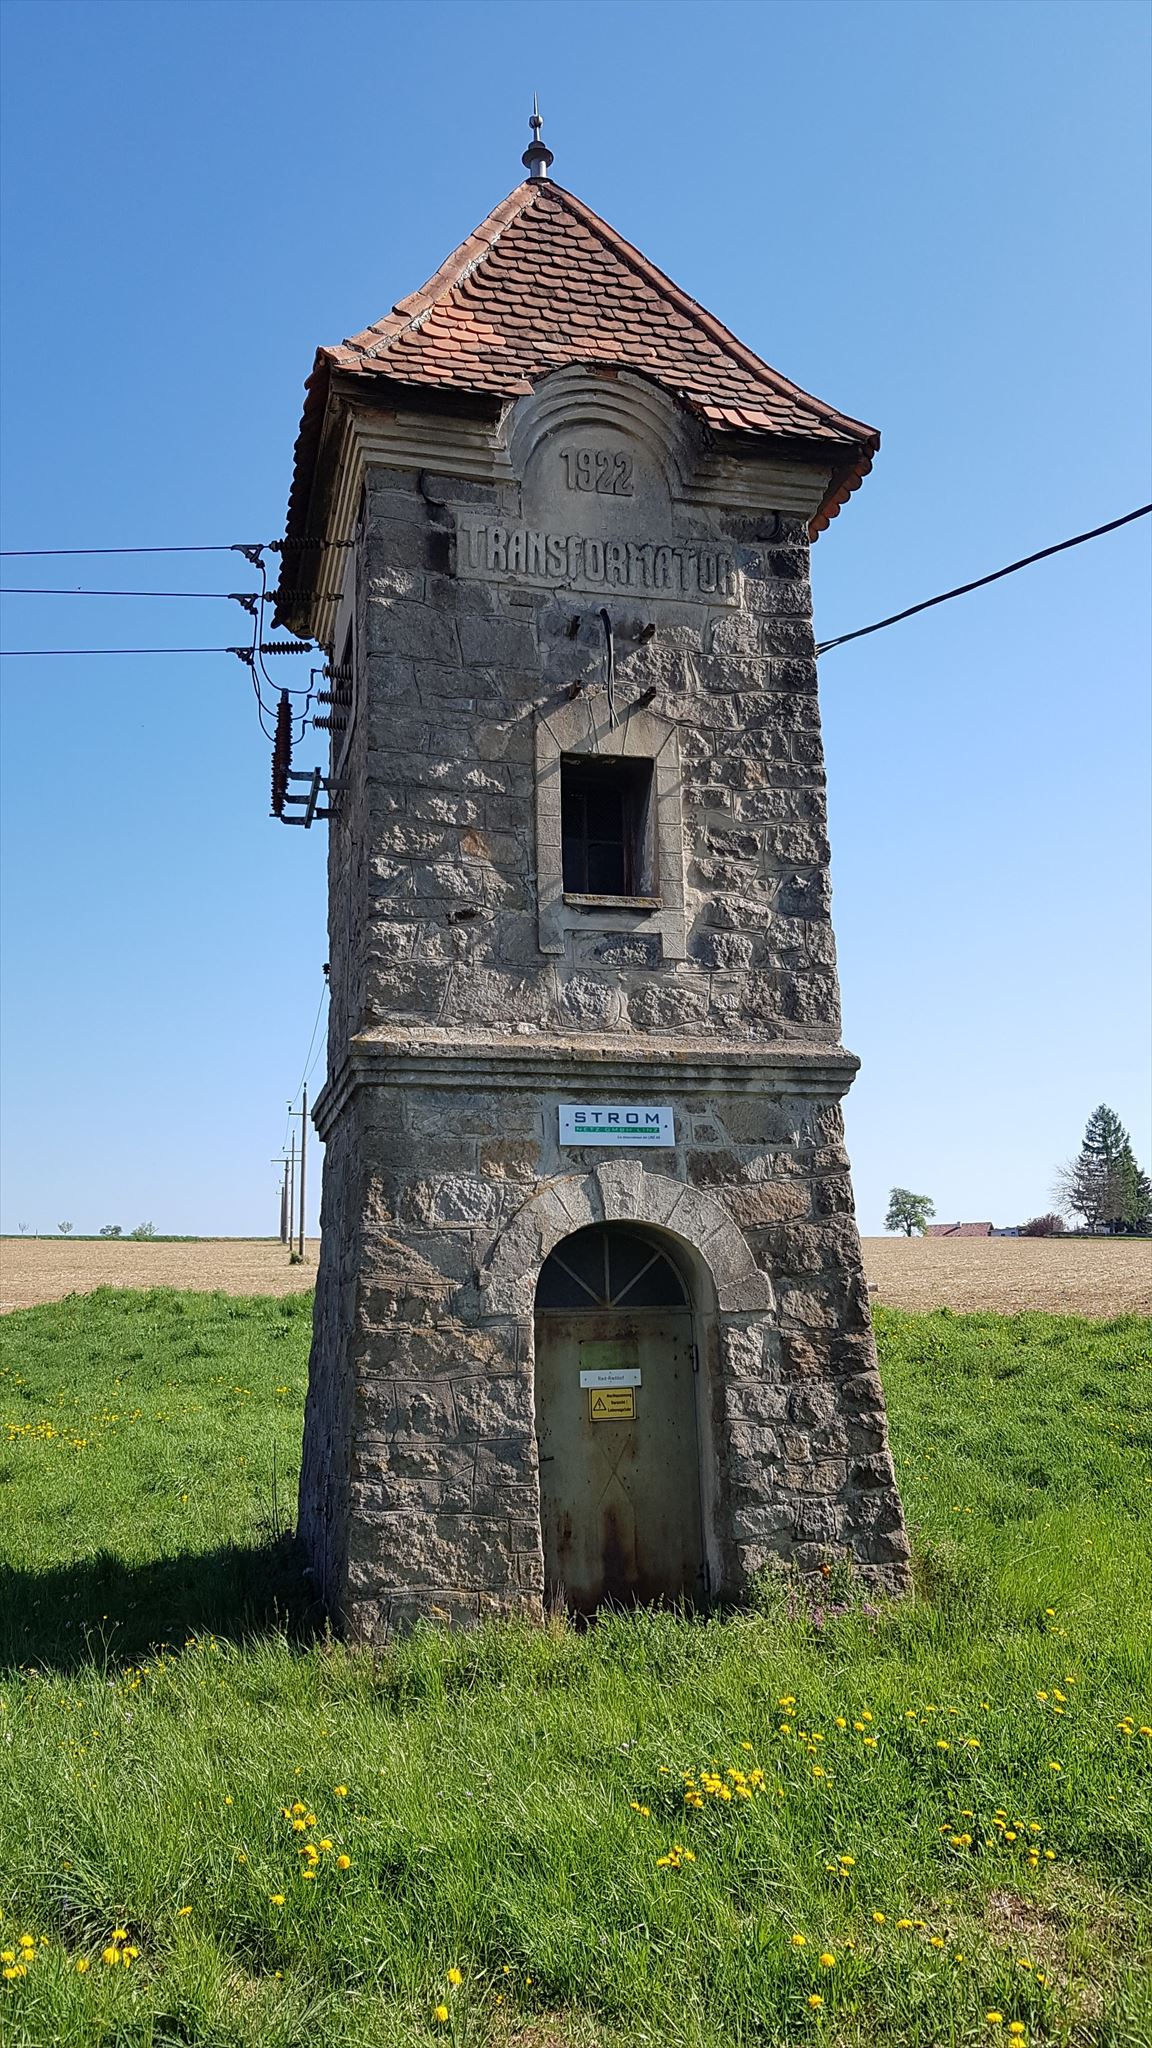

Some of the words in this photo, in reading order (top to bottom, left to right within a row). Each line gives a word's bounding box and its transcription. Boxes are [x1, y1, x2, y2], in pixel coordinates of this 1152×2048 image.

[560, 447, 634, 497] 1922
[461, 523, 738, 596] TRANSFORMATOR
[574, 1111, 660, 1124] STROM
